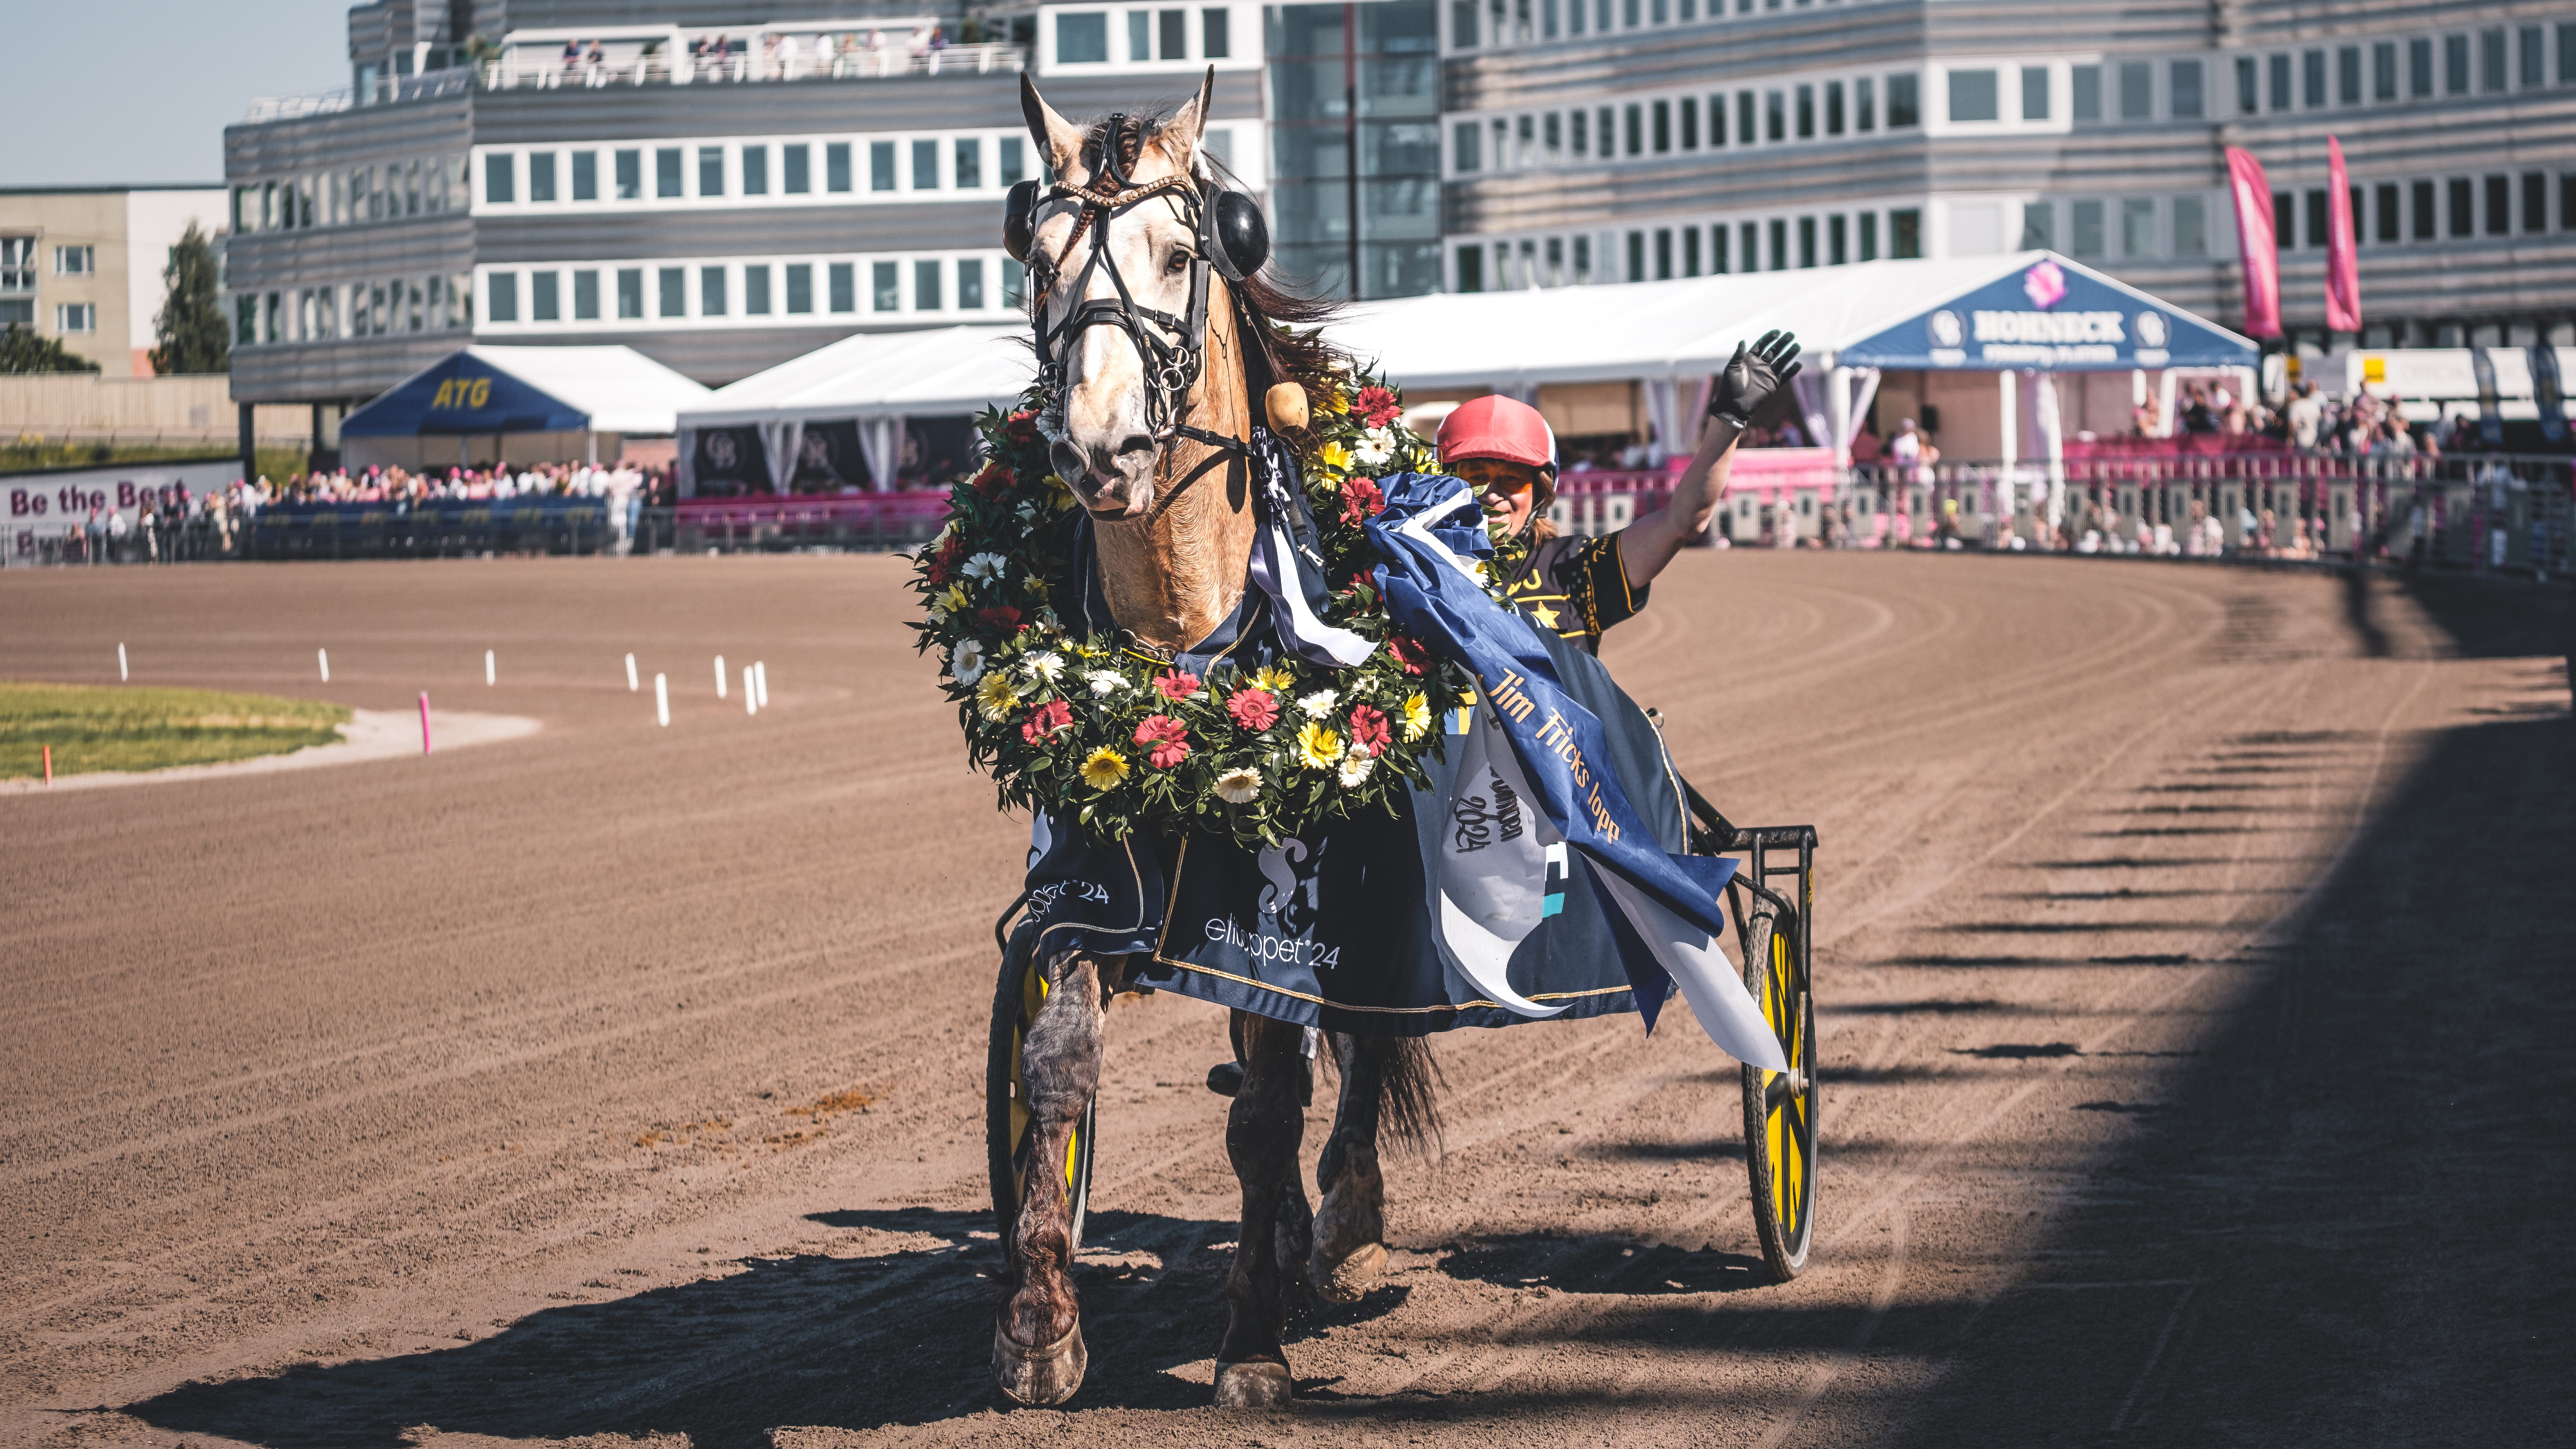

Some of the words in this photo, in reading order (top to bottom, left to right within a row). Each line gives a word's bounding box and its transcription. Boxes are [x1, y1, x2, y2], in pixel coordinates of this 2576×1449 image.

[431, 378, 492, 409] ATG
[11, 487, 48, 517] Be
[59, 483, 106, 514] the
[1478, 667, 1535, 724] Jim
[1588, 781, 1620, 844] lopp
[1453, 796, 1492, 853] 2024
[1308, 943, 1340, 969] 24
